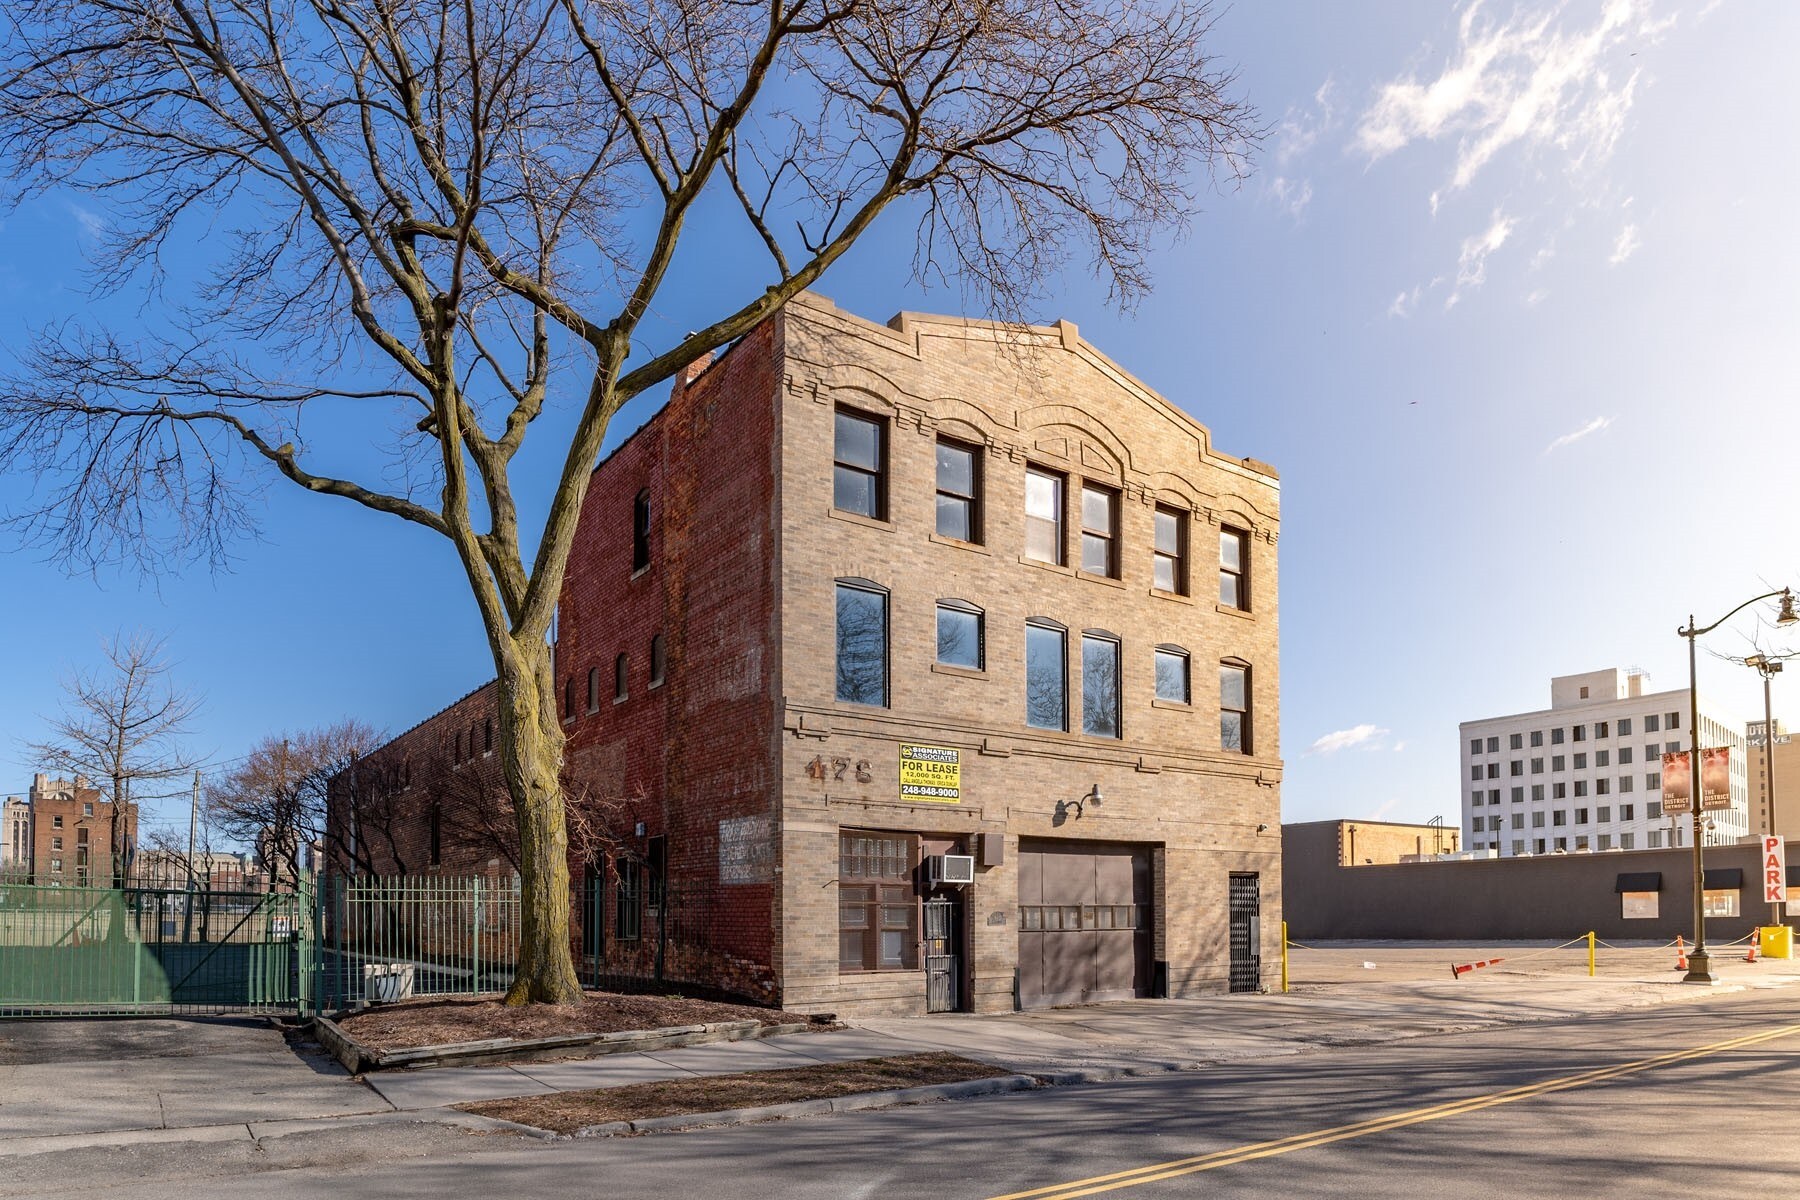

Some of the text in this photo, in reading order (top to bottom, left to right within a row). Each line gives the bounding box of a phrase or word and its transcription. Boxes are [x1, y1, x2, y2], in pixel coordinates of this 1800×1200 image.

[912, 747, 957, 757] SIGNATURE
[912, 752, 957, 763] ASSOCIATES
[902, 761, 958, 774] FOR LEASE
[902, 785, 958, 798] 248-948-9000
[1704, 793, 1729, 801] DISTRICT
[1765, 838, 1781, 901] PARK
